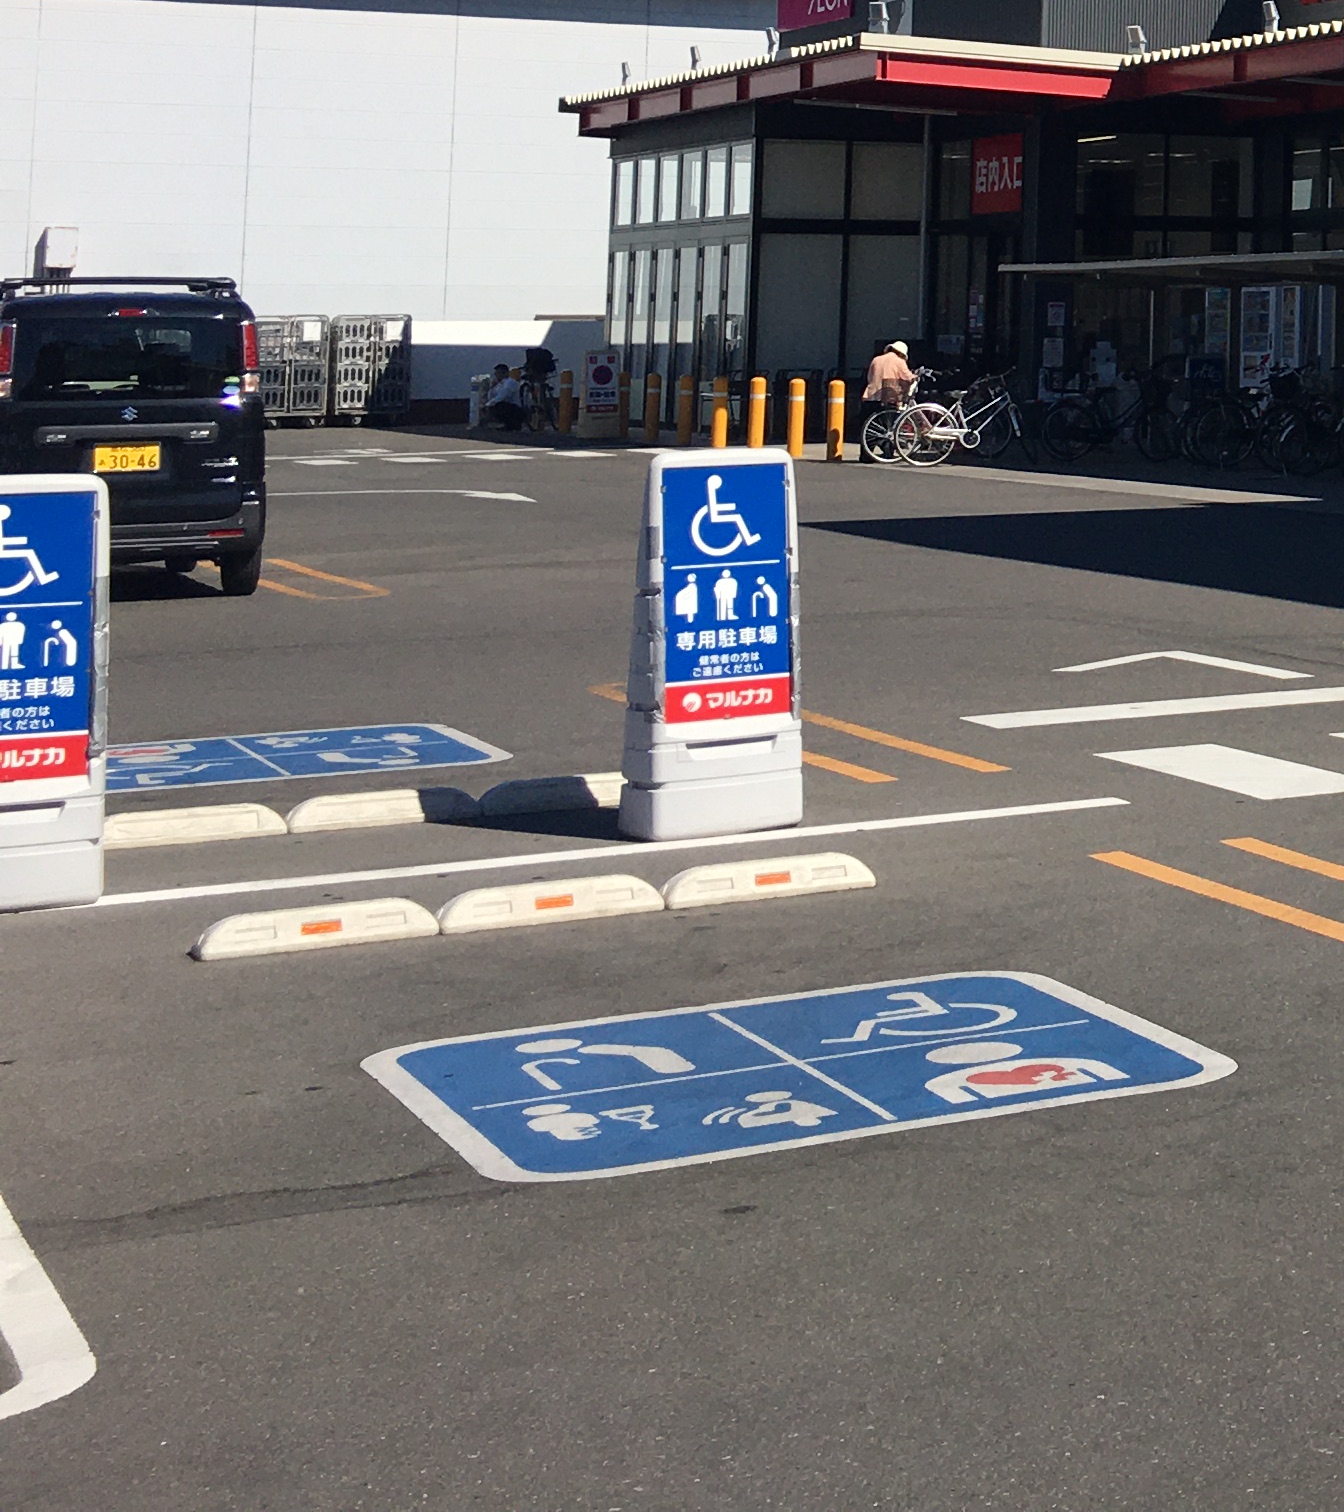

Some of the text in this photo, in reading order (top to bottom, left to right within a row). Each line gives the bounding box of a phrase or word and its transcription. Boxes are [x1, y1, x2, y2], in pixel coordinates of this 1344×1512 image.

[109, 453, 157, 469] 30-46
[676, 625, 778, 652] 専用駐車場
[698, 651, 760, 666] 健常者の方は
[692, 664, 764, 678] ご遠慮ください
[705, 688, 773, 708] マルナカ
[0, 718, 55, 731] ください
[0, 747, 66, 769] ルナカ
